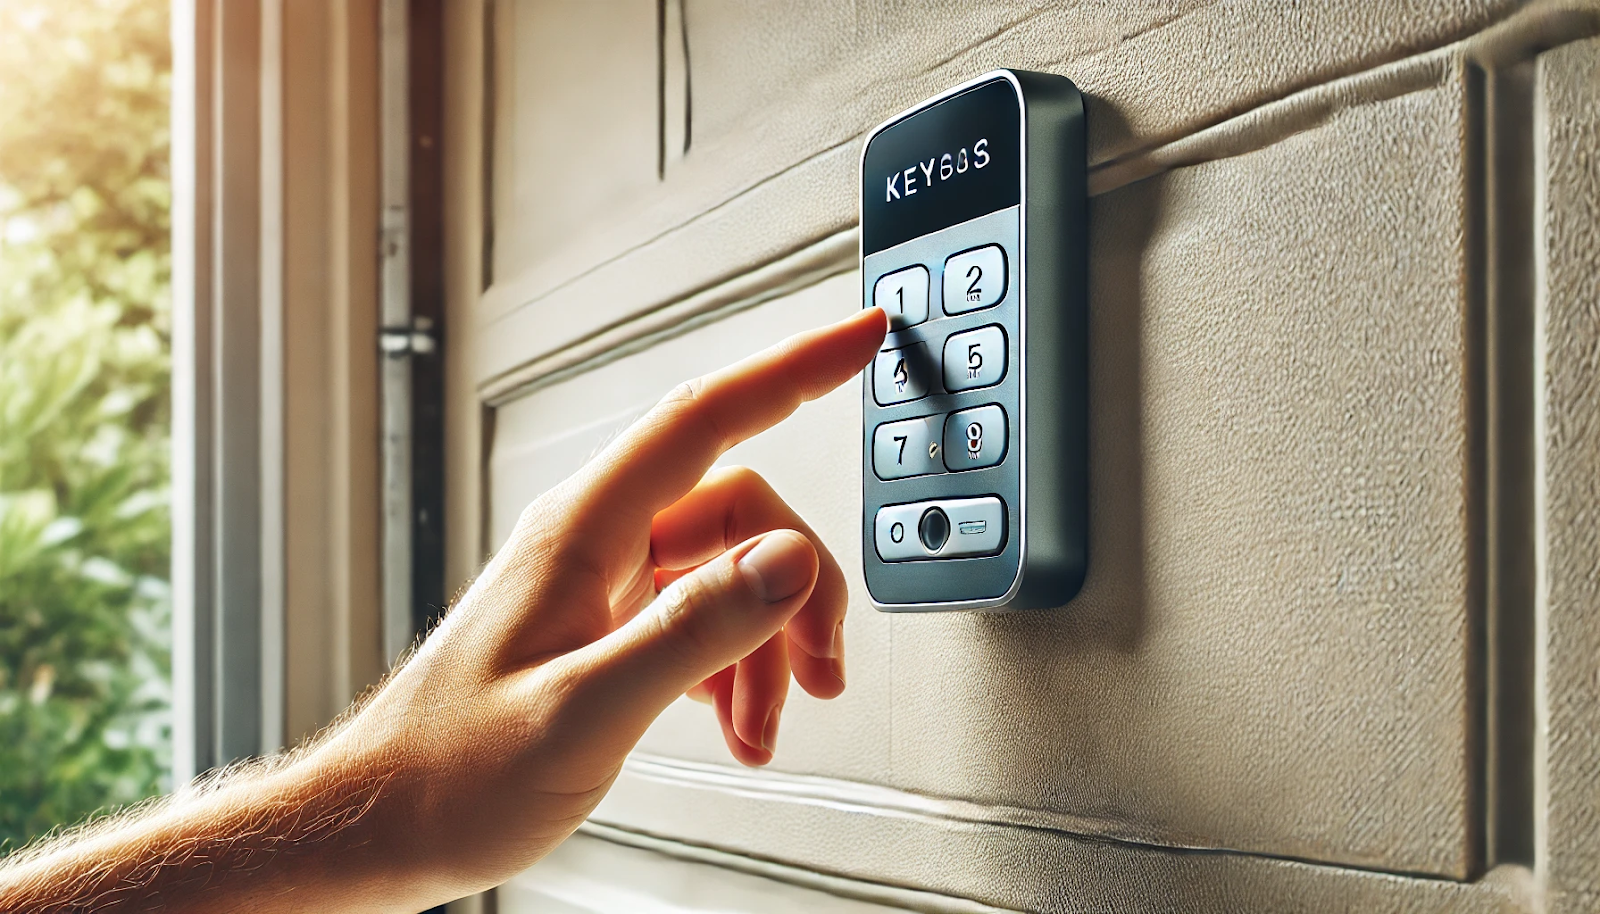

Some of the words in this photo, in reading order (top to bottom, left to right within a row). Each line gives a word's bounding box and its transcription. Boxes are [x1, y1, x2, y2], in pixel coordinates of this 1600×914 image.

[965, 265, 983, 296] 2
[895, 285, 904, 315] 1
[967, 343, 983, 371] 5
[893, 435, 908, 466] 7
